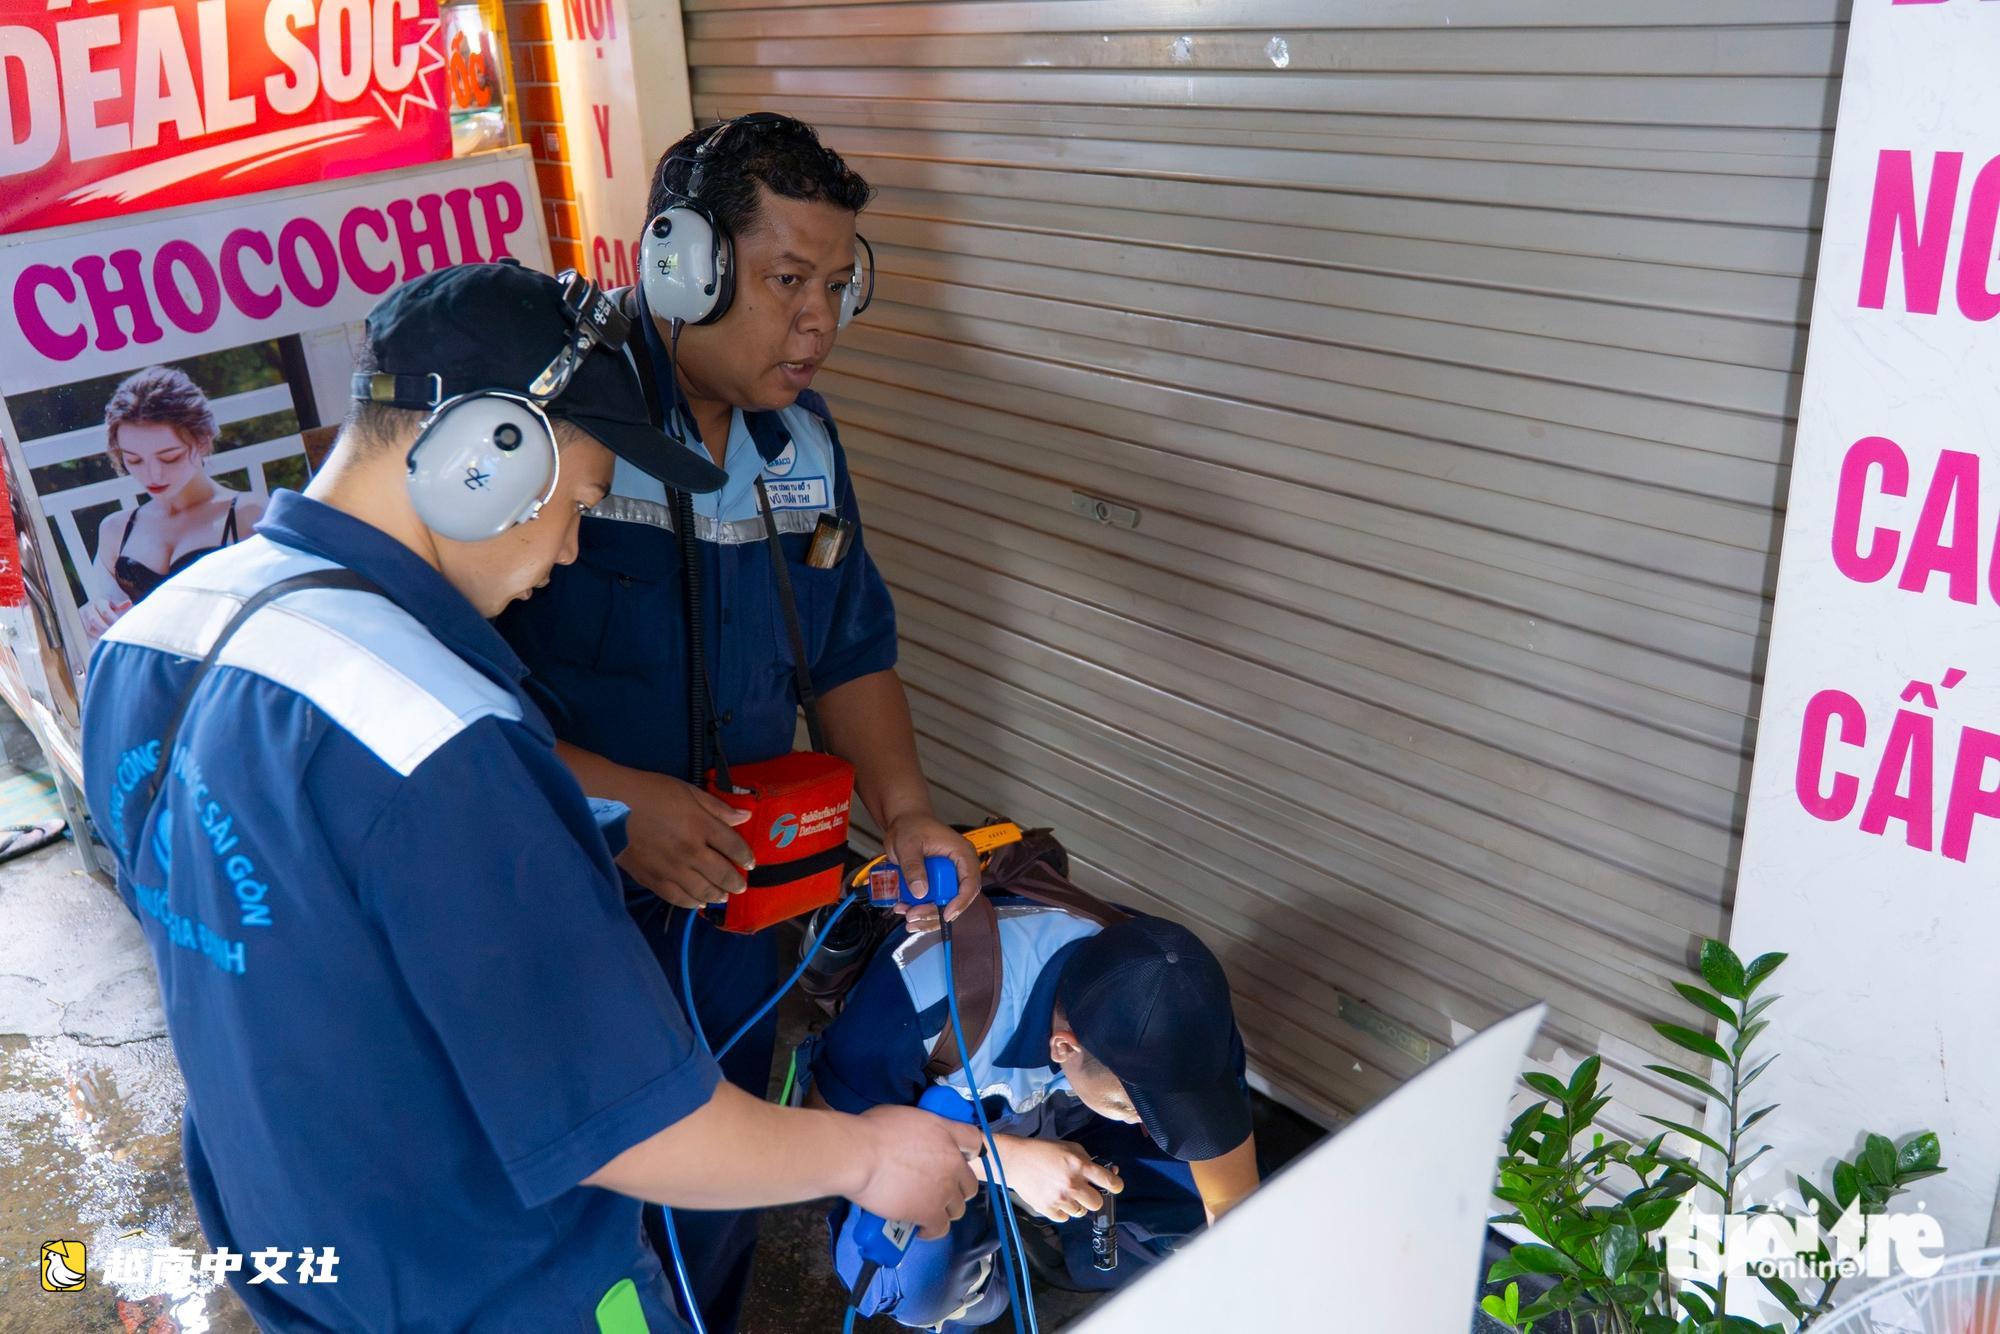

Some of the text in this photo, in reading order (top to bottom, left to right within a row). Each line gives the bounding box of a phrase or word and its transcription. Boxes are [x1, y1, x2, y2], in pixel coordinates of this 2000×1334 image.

[0, 0, 256, 177] DEAL
[592, 104, 614, 179] Y
[13, 181, 525, 362] CHOCOCHIP
[1831, 436, 2000, 609] CA
[1796, 668, 2000, 863] CẤP
